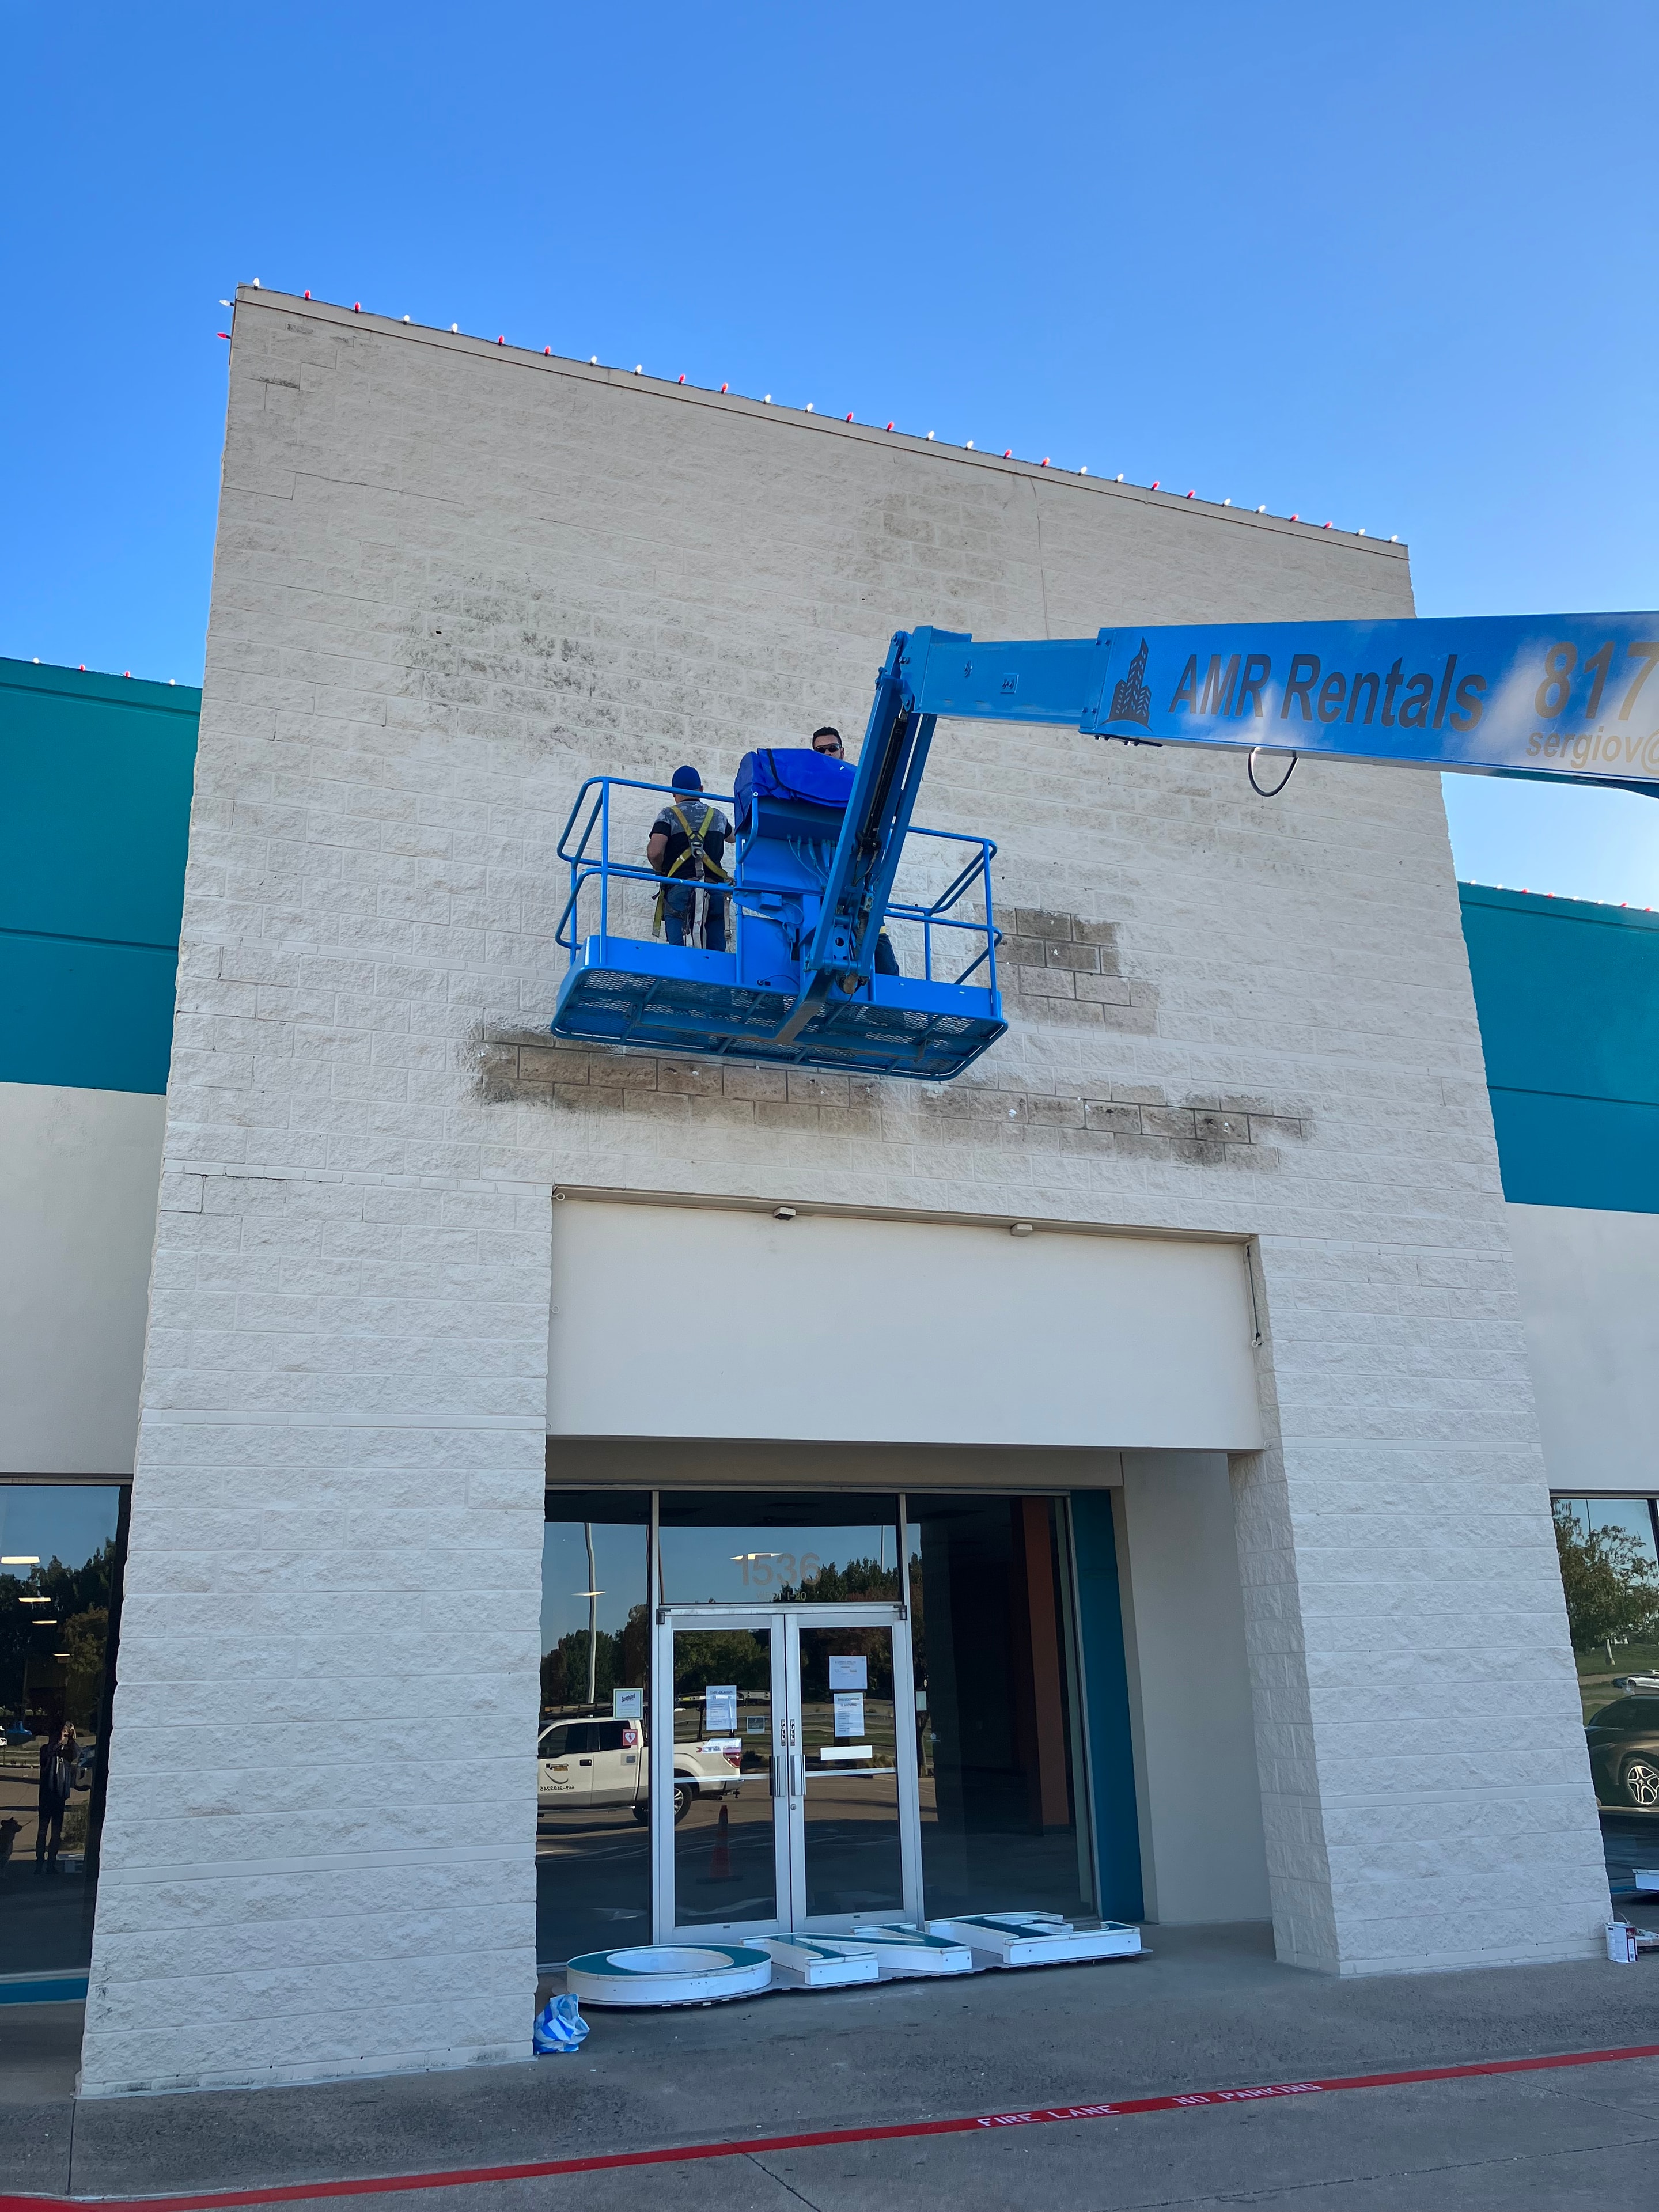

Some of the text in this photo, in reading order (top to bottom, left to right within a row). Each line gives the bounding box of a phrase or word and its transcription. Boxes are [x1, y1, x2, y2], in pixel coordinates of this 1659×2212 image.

[1168, 641, 1659, 732] AMR Rentals 817
[734, 1552, 821, 1585] 1536
[787, 1591, 806, 1600] I-20
[976, 2083, 1323, 2127] FIRE LANE NO PARKING
